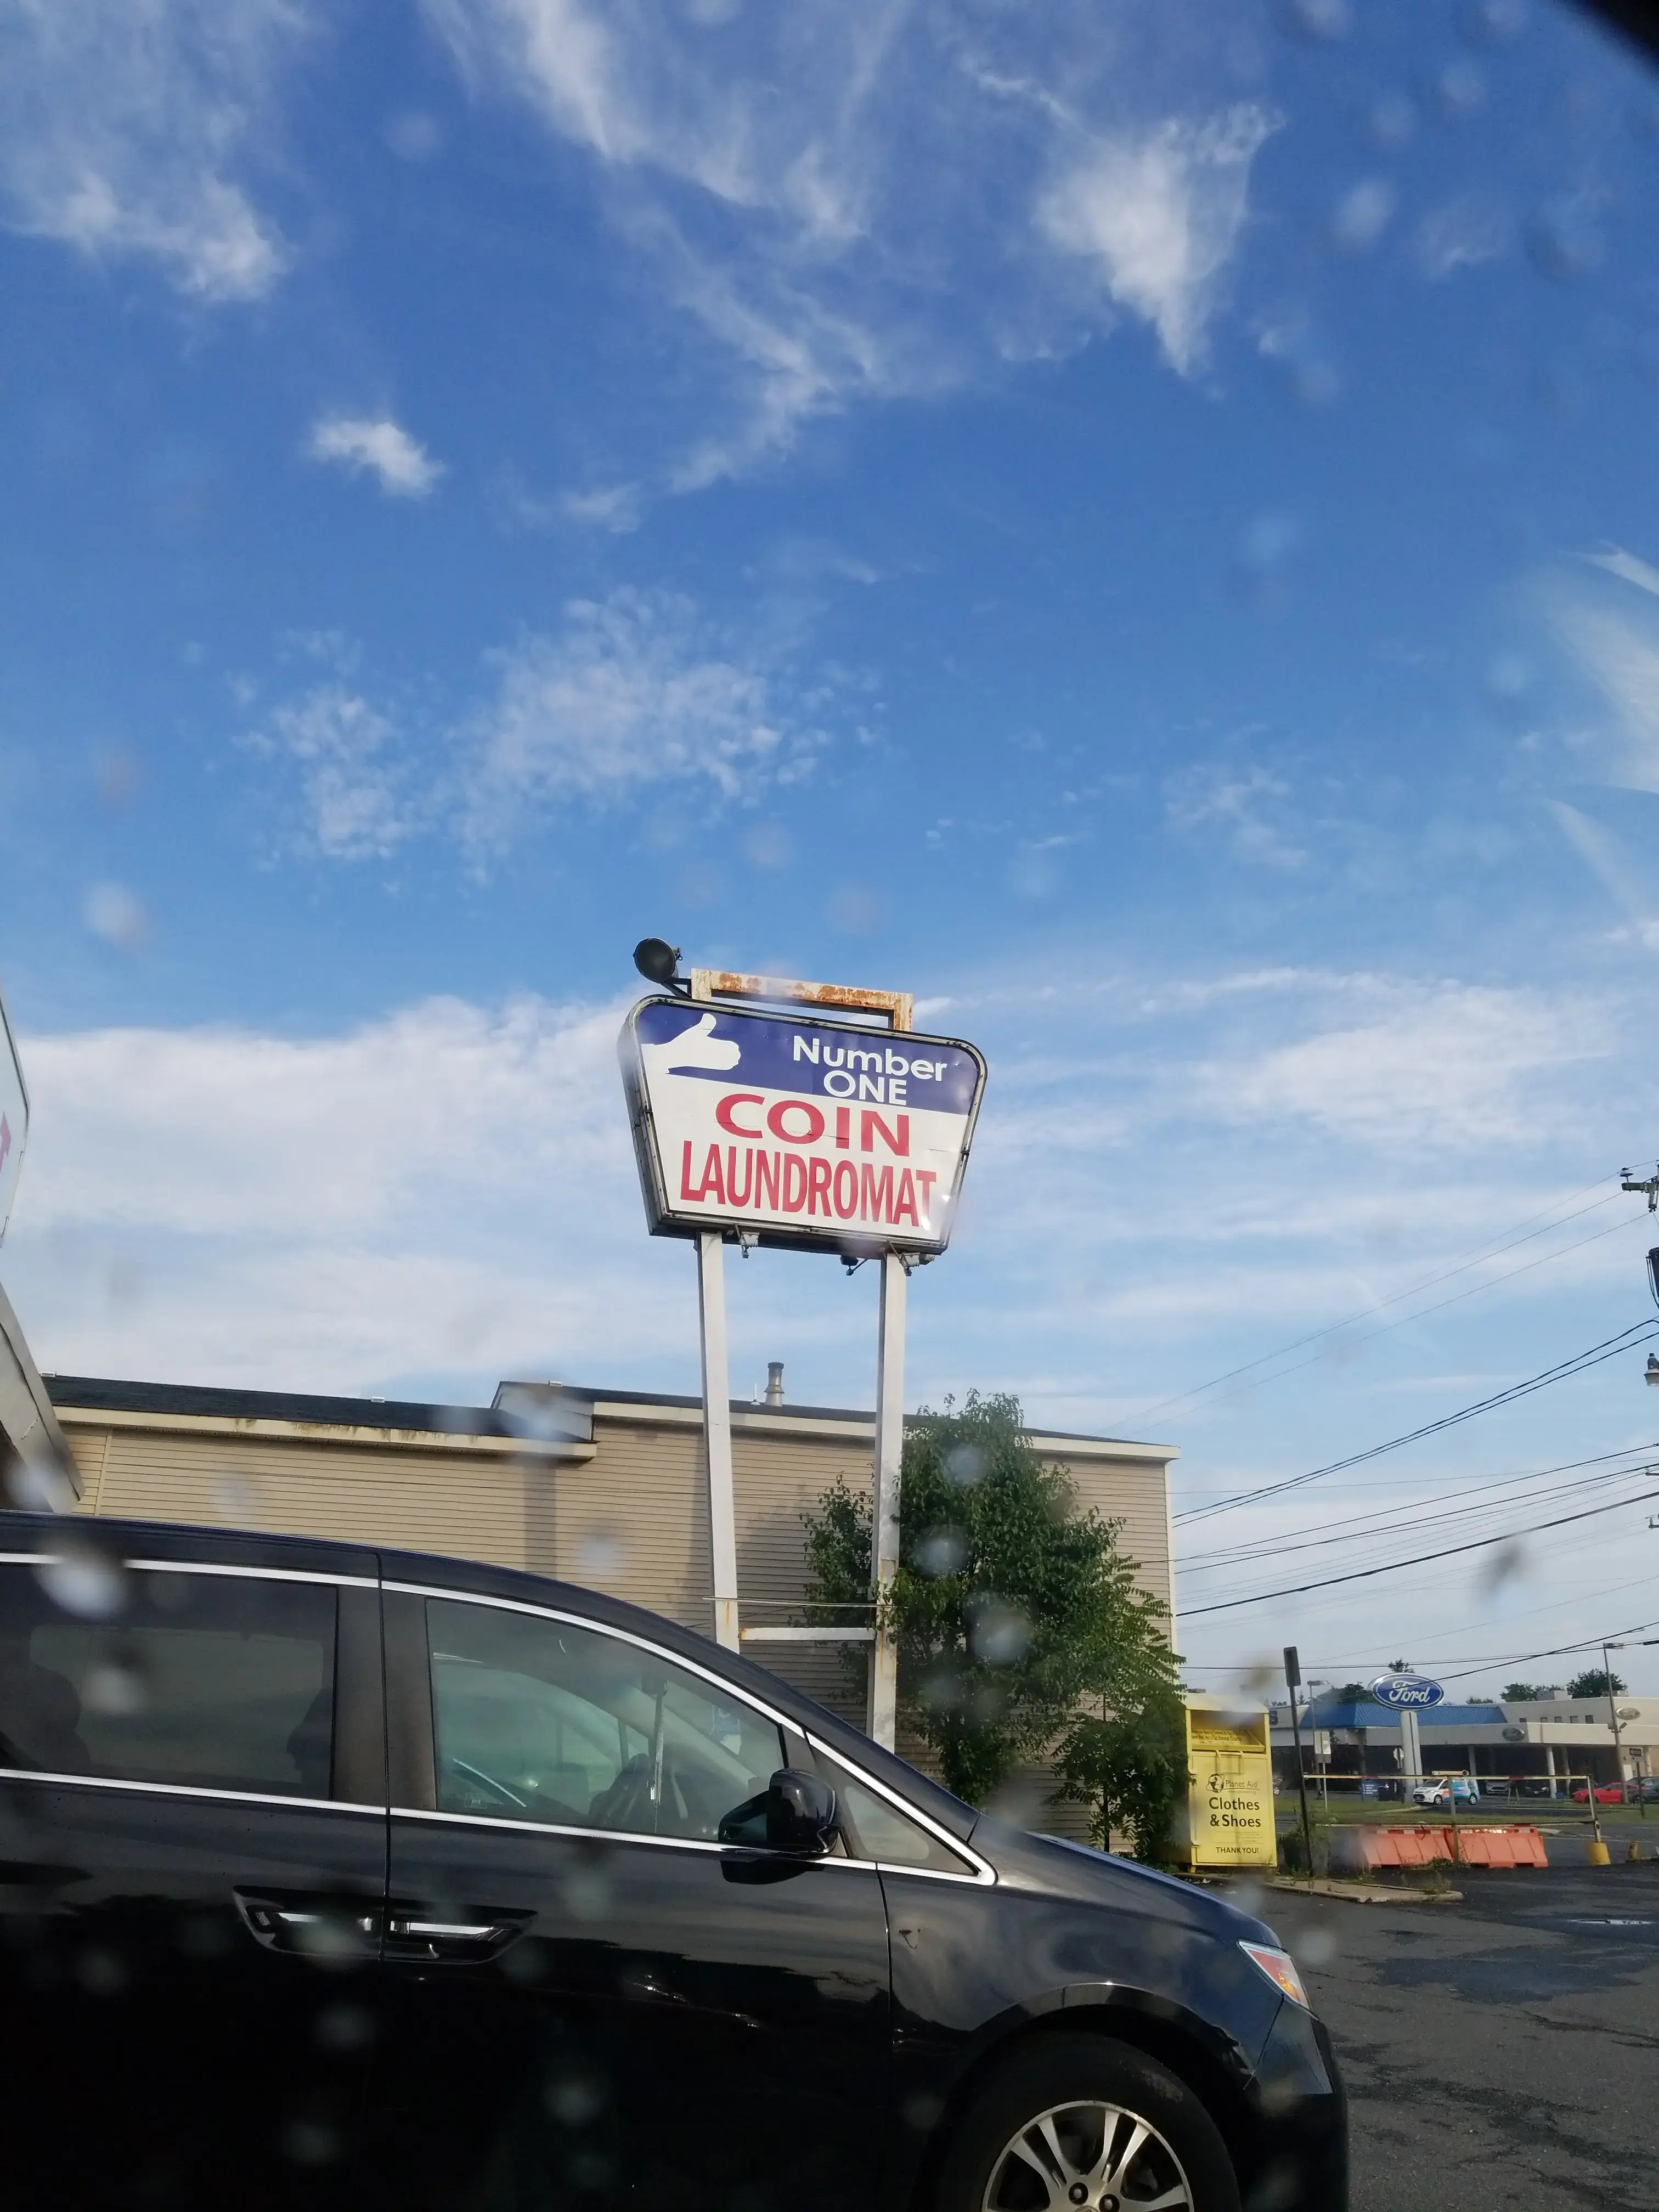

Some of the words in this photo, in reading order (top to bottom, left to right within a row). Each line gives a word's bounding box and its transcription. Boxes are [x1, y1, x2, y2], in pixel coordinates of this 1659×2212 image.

[793, 1035, 948, 1082] Number
[823, 1070, 907, 1106] ONE
[715, 1093, 910, 1158] COIN
[680, 1139, 937, 1227] LAUNDROMAT
[1389, 1680, 1430, 1703] Ford
[1225, 1780, 1245, 1788] Planet
[1209, 1797, 1260, 1810] Clothes
[1210, 1814, 1220, 1827] &
[1222, 1814, 1261, 1827] Shoes
